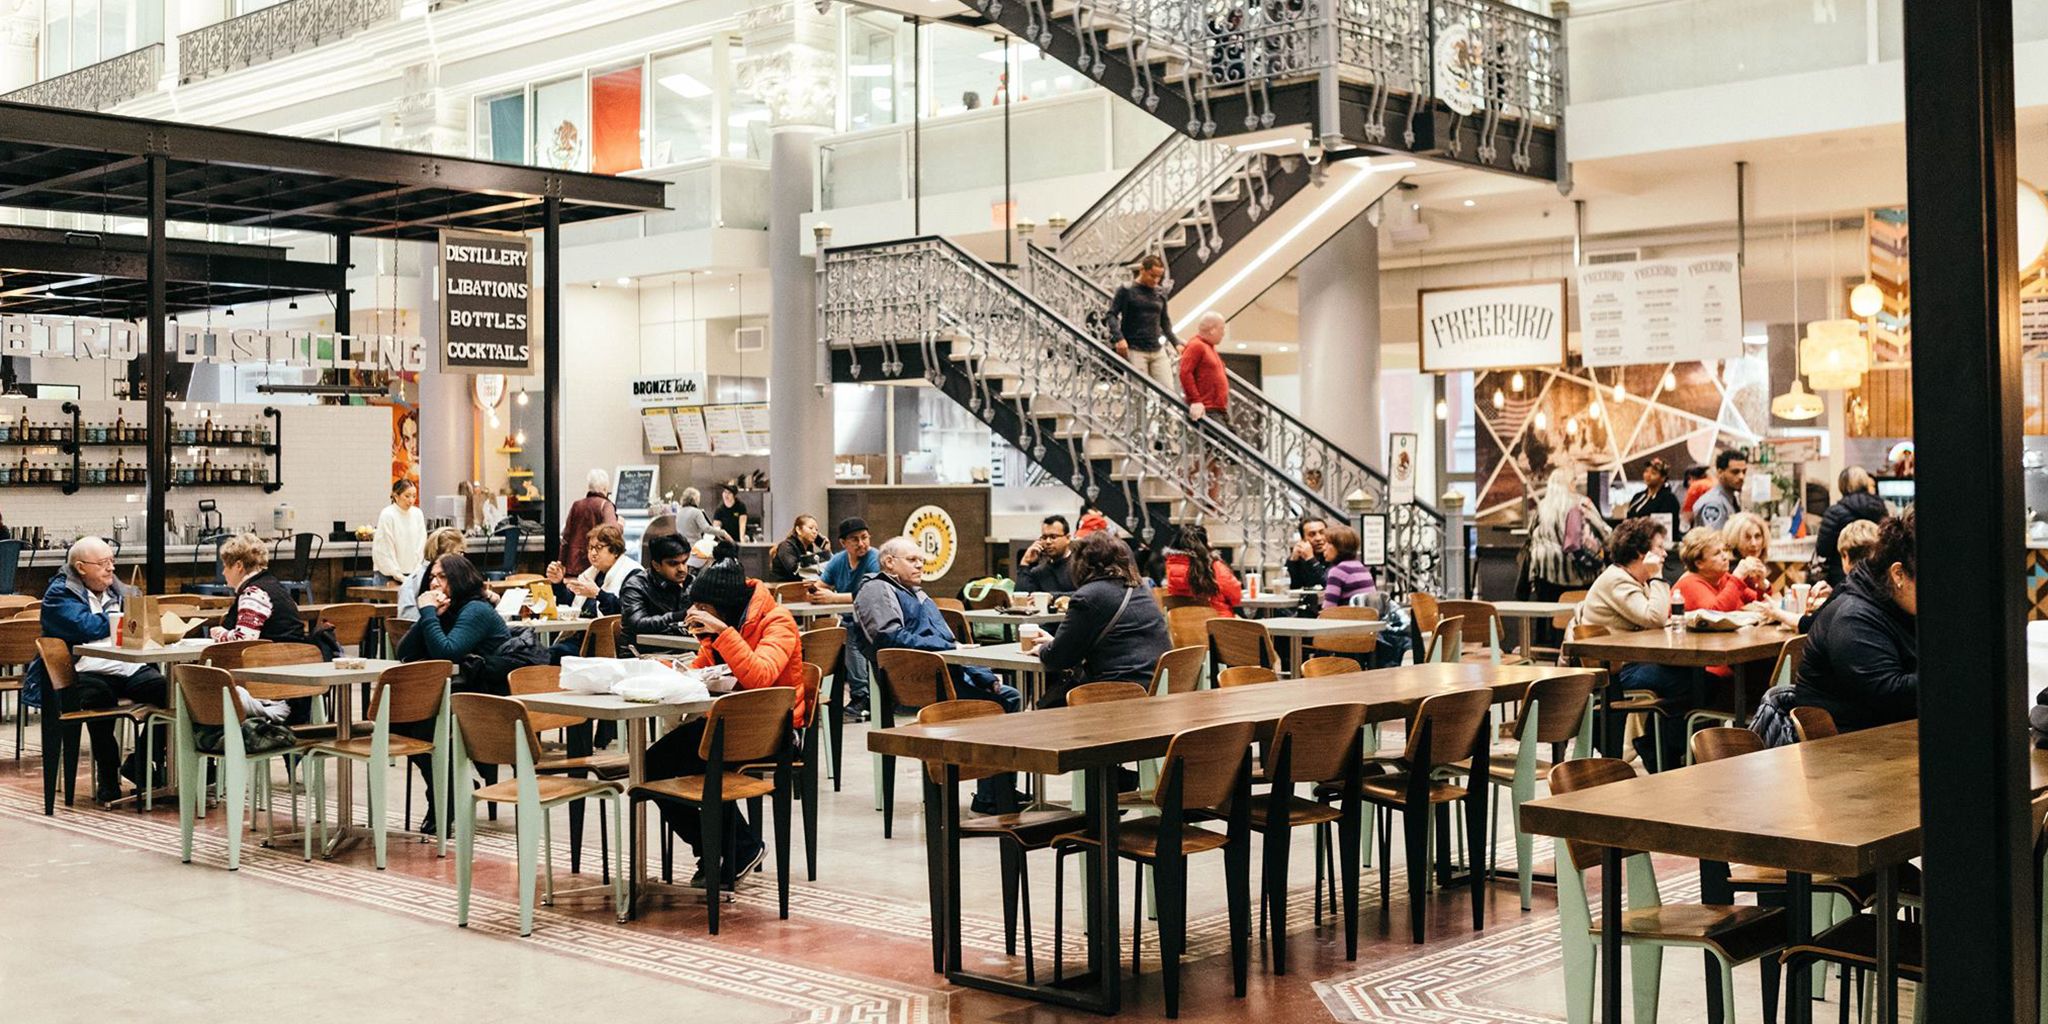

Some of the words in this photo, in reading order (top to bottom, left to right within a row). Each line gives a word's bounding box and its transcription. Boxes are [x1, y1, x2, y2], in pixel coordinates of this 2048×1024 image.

[446, 244, 528, 267] DISTILLERY
[447, 278, 528, 300] LIBATIONS
[449, 310, 527, 330] BOTTLES
[1430, 303, 1554, 348] FREEBYRD
[1, 314, 139, 361] BIRD
[177, 325, 427, 372] DISTILLING
[447, 342, 530, 361] COCKTAILS
[633, 379, 672, 395] BRONZE
[673, 378, 696, 393] Table
